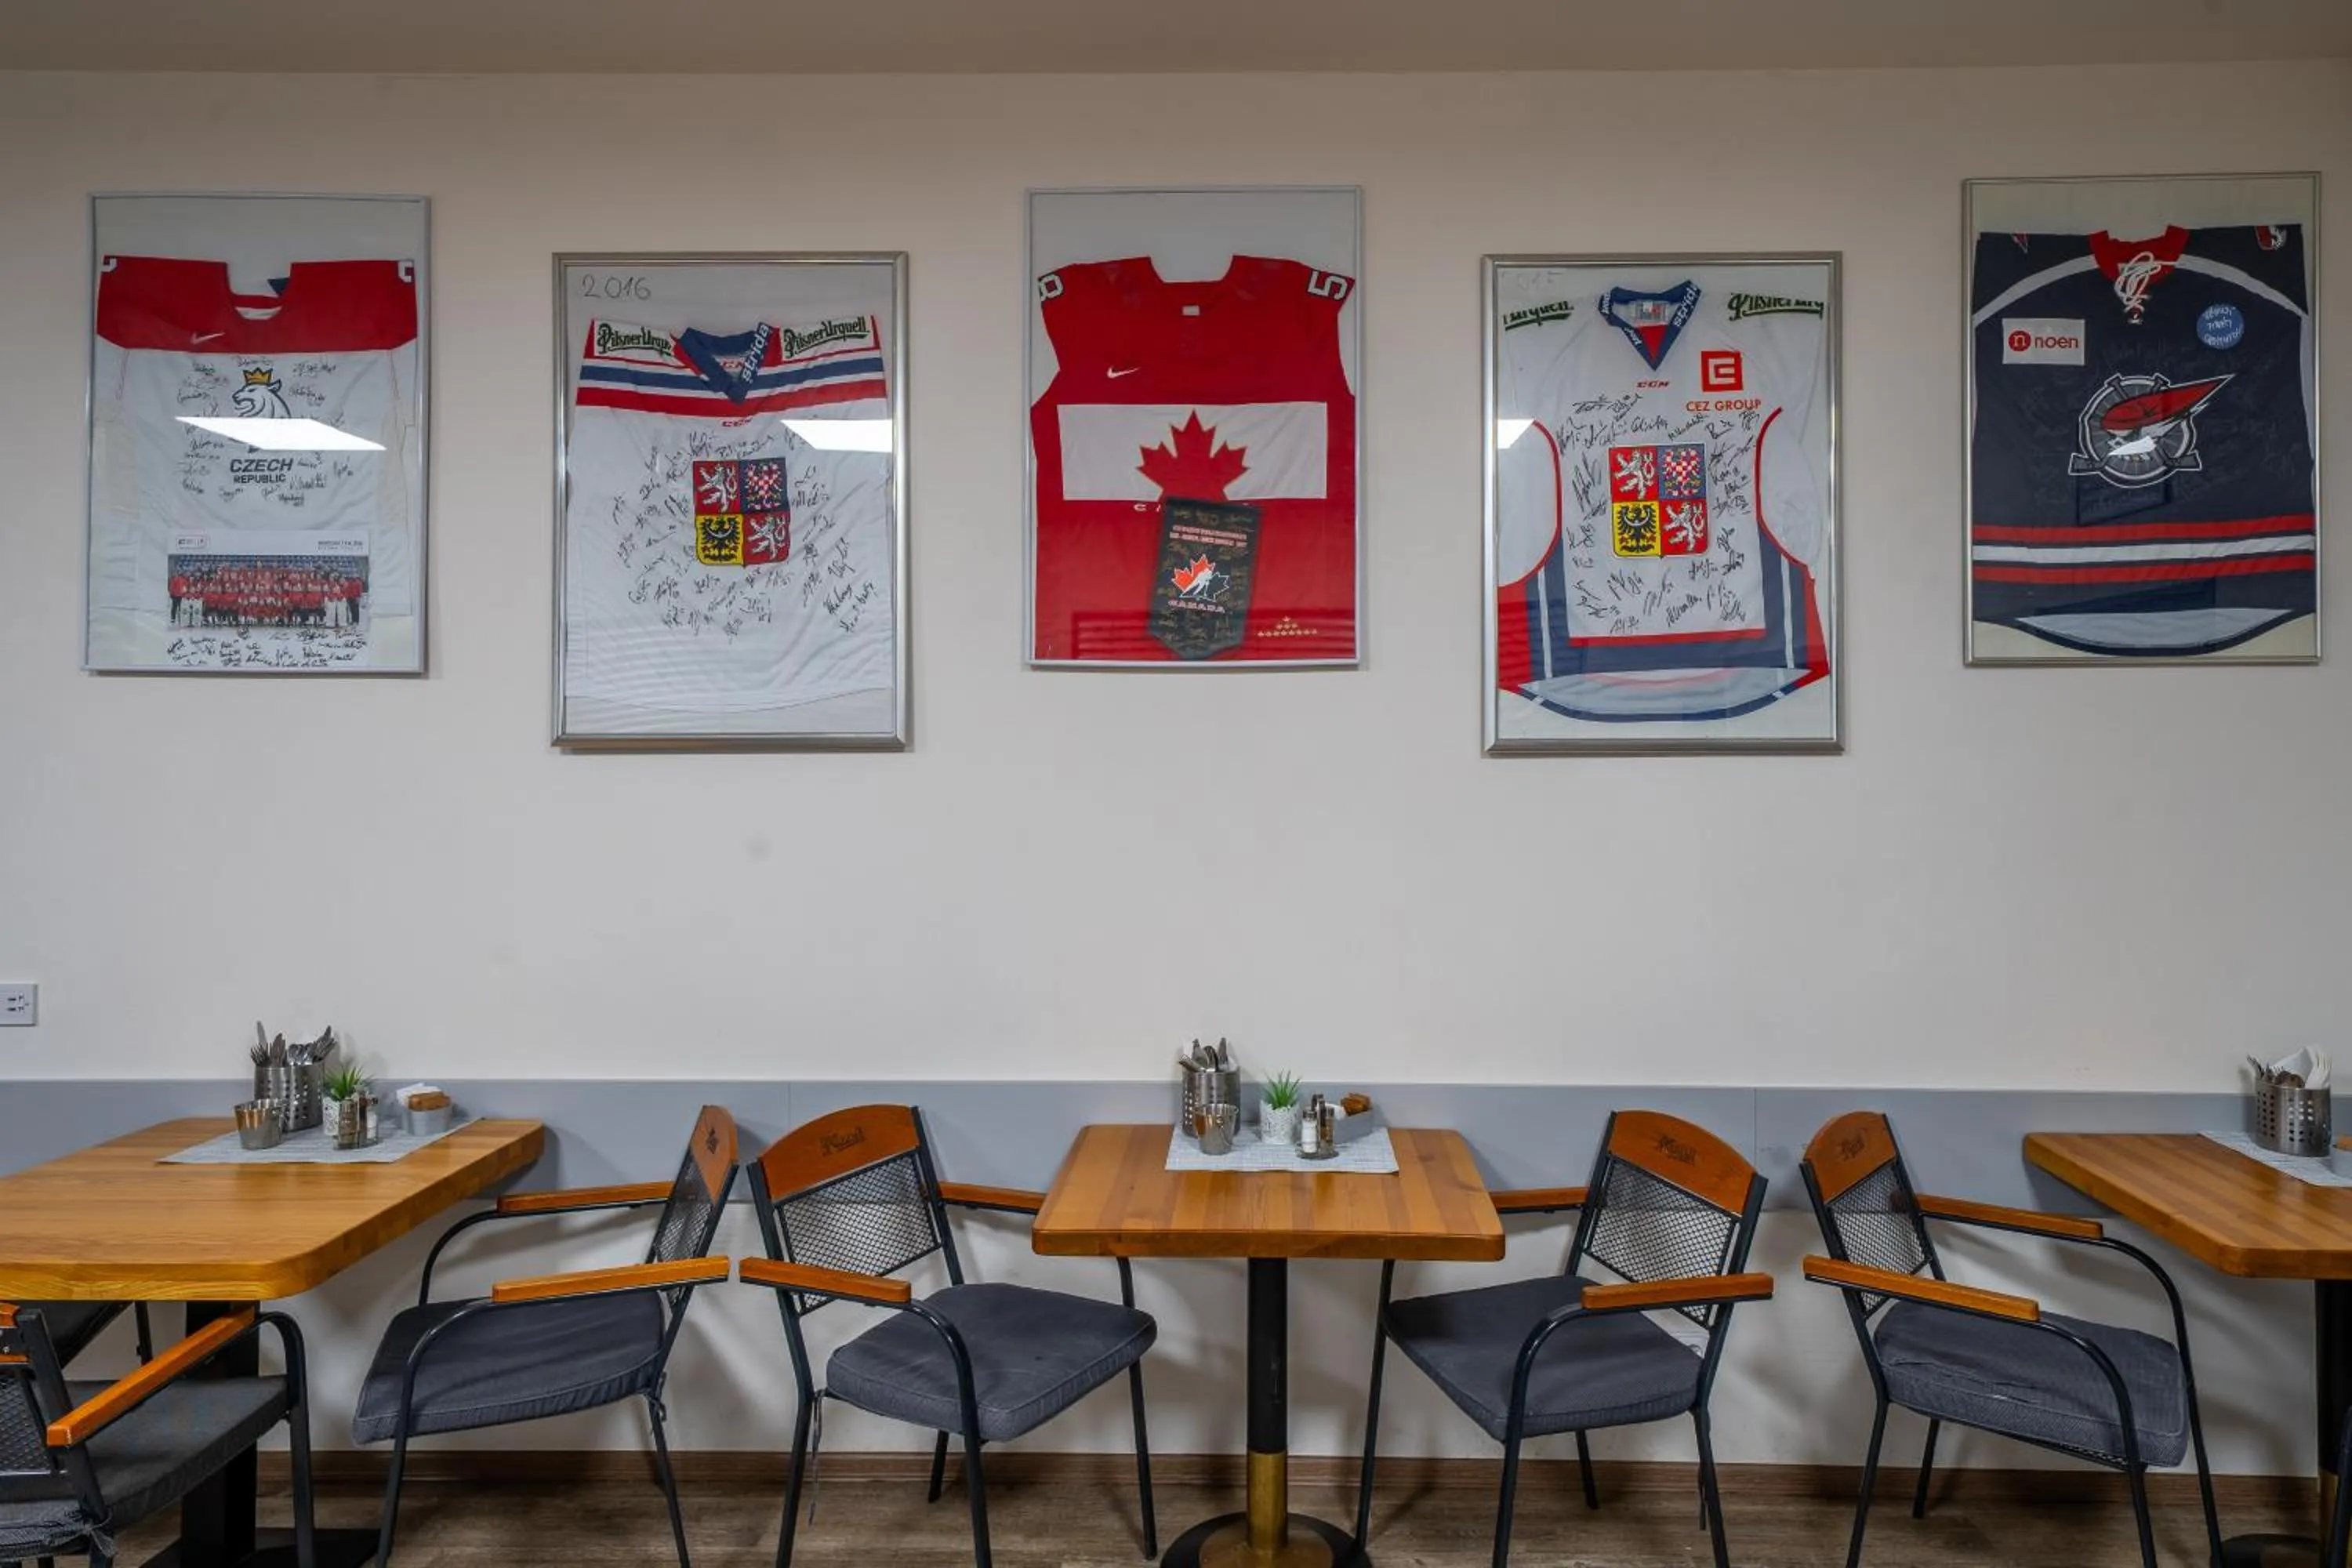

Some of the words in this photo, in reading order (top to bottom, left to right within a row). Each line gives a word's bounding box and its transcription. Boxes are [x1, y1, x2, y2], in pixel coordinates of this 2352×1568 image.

[583, 274, 652, 300] 2016
[2034, 336, 2079, 349] noen
[1686, 401, 1710, 412] CEZ
[1715, 399, 1762, 412] GROUP
[230, 458, 294, 474] CZECH
[233, 473, 287, 484] REPUBLIC
